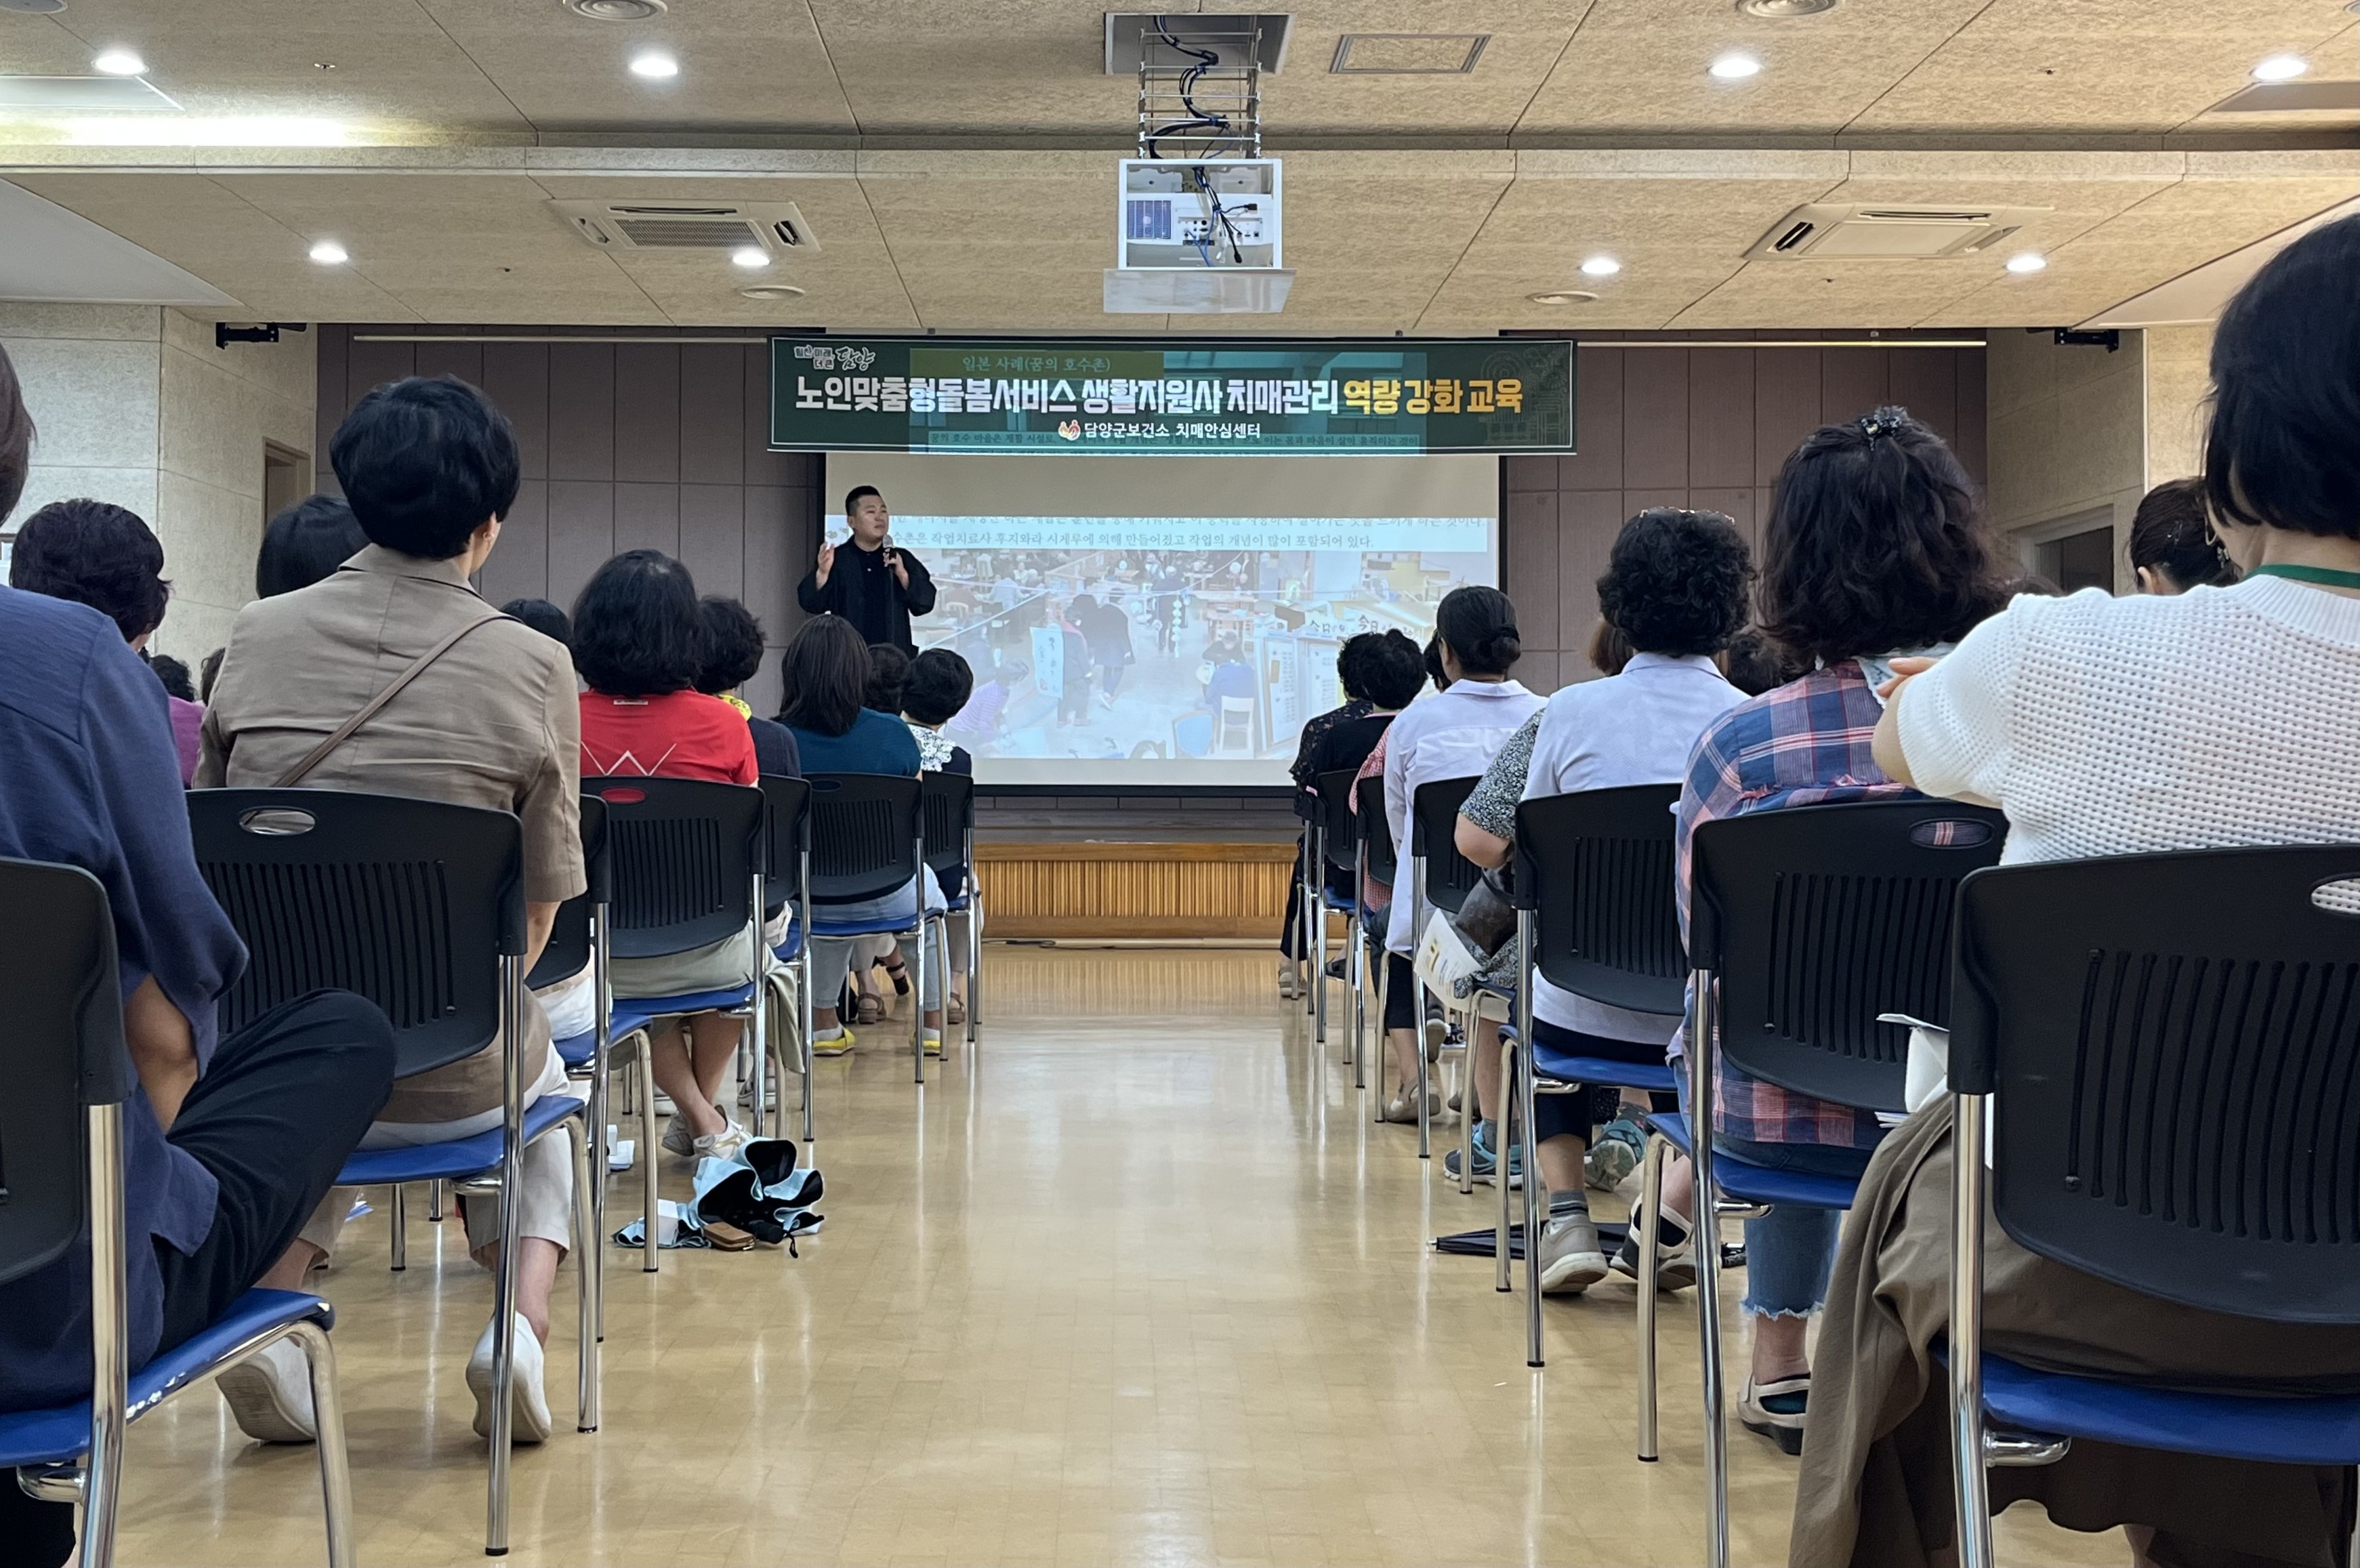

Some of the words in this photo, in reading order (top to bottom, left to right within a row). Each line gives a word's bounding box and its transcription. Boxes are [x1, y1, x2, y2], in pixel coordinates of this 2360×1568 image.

[963, 356, 991, 371] 일본
[995, 356, 1058, 371] 사례(꿈의
[1063, 357, 1111, 372] 호수촌)
[795, 377, 1077, 413] 노인맞춤형돌봄서비스
[1081, 379, 1223, 414] 생활지원사
[1226, 379, 1338, 415] 치매관리
[1344, 379, 1400, 414] 역량
[1405, 379, 1462, 414] 강화
[1467, 379, 1523, 413] 교육
[1084, 422, 1169, 438] 담양군보건소
[1176, 423, 1260, 439] 치매안심센터
[932, 531, 991, 545] 작업치료사
[996, 532, 1043, 545] 후지와라
[1048, 533, 1094, 546] 시게루에
[1098, 533, 1121, 546] 의해
[1125, 533, 1185, 547] 만들어졌고
[1189, 534, 1224, 548] 작업의
[1229, 534, 1263, 548] 개념이
[1268, 535, 1291, 548] 많이
[1296, 535, 1342, 548] 포함되어
